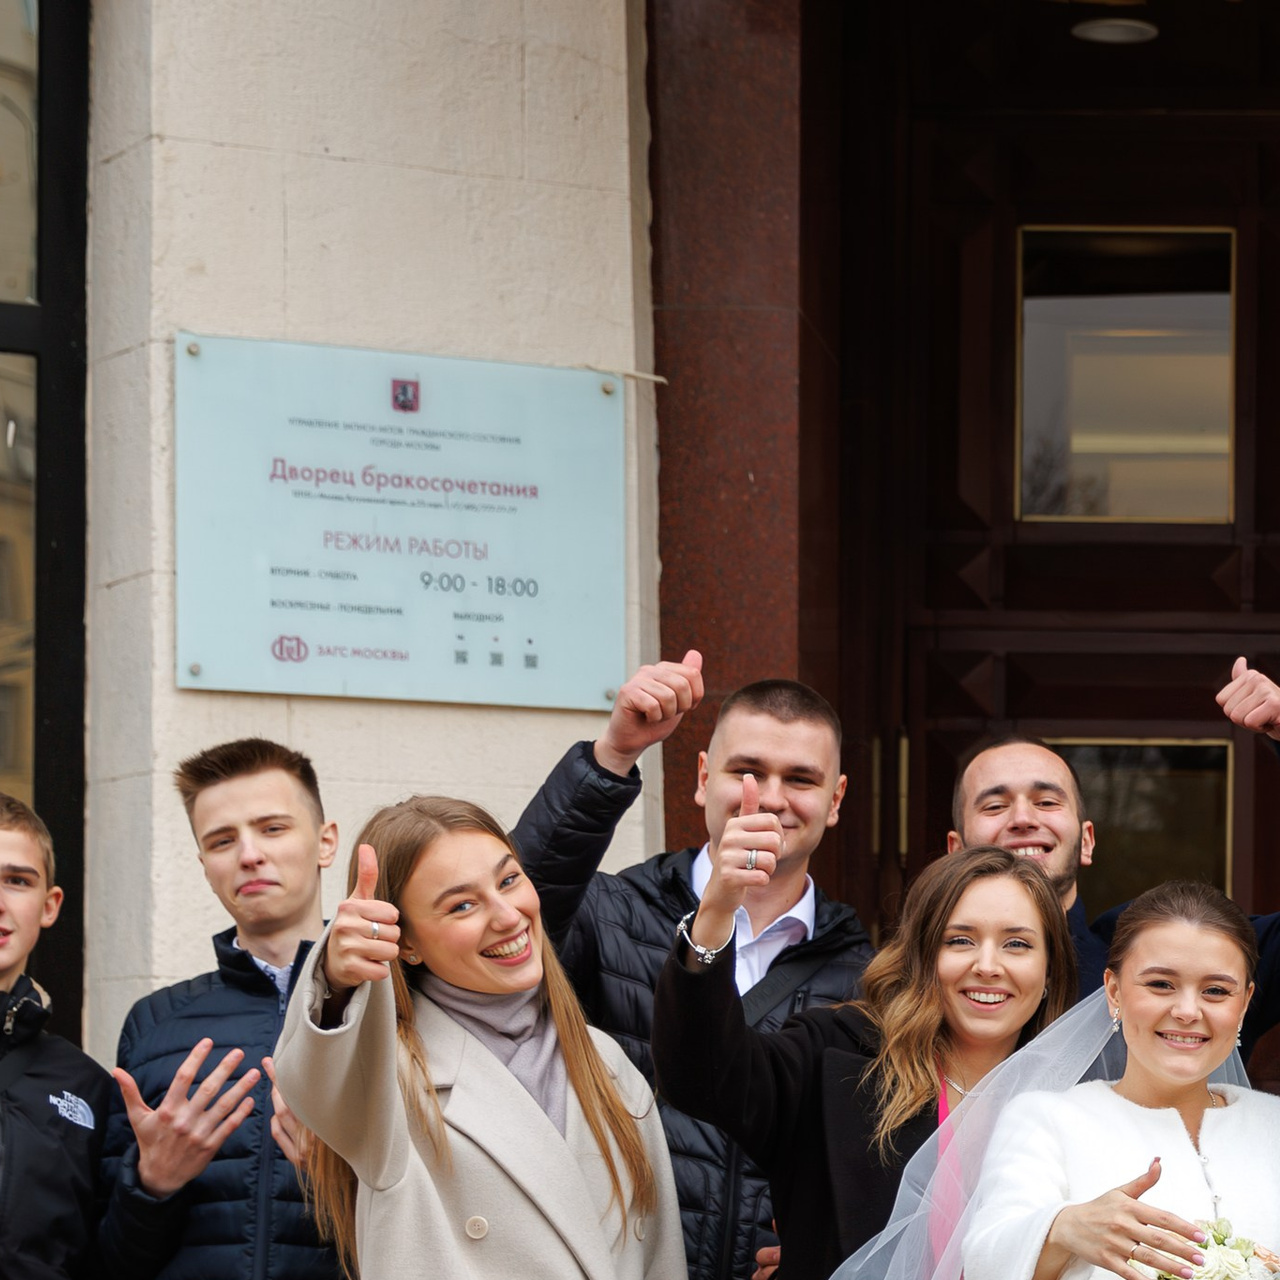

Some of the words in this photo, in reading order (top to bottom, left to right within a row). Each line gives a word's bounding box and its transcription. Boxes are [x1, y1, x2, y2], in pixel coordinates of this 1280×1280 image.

[269, 457, 356, 487] Дворец
[361, 464, 539, 499] бракосочетания
[322, 530, 402, 555] РЕЖИМ
[408, 536, 489, 561] РАБОТЫ
[420, 571, 466, 593] 9:00
[487, 576, 539, 598] 18:00
[317, 645, 348, 658] ЗАГС
[350, 648, 409, 662] МОСКВЫ
